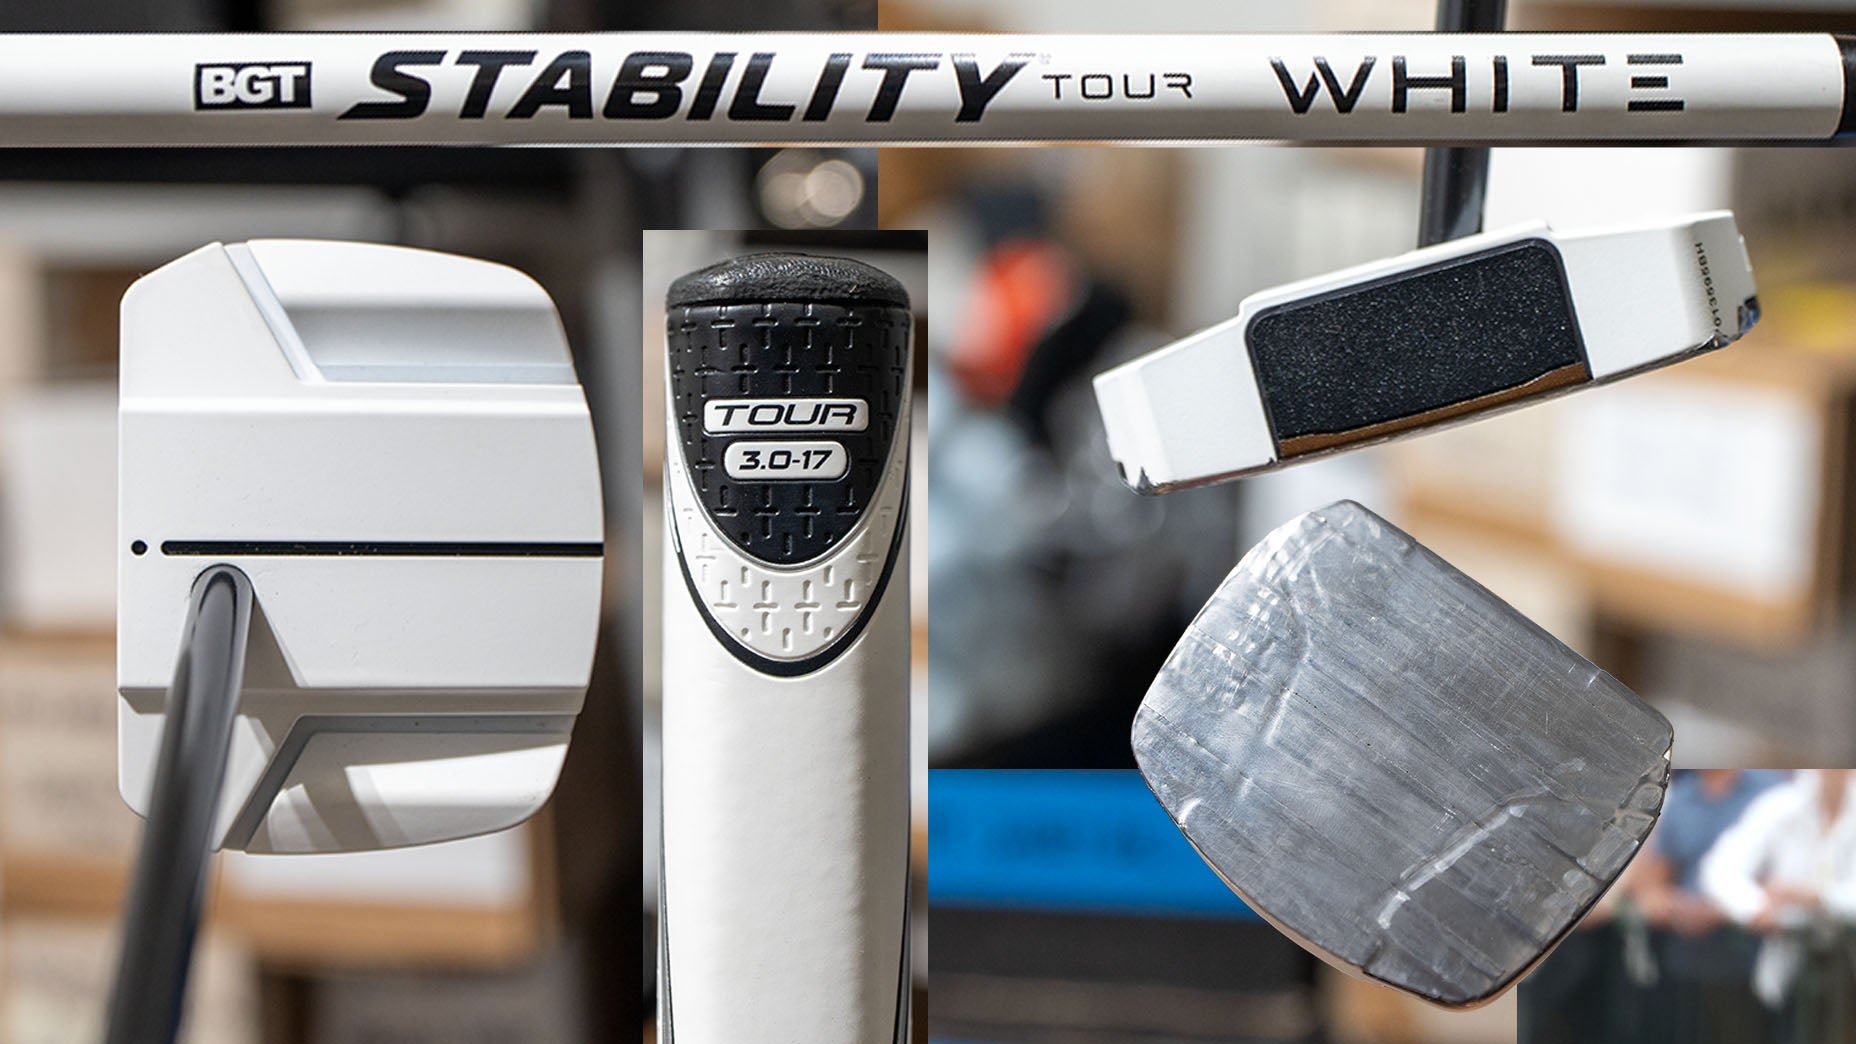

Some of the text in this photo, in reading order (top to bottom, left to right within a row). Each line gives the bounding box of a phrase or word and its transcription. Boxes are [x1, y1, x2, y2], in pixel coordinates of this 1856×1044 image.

[200, 49, 1685, 122] BGT STABILITY TOUR WHITE
[714, 403, 858, 426] TOUR
[739, 449, 833, 470] 3.0-17
